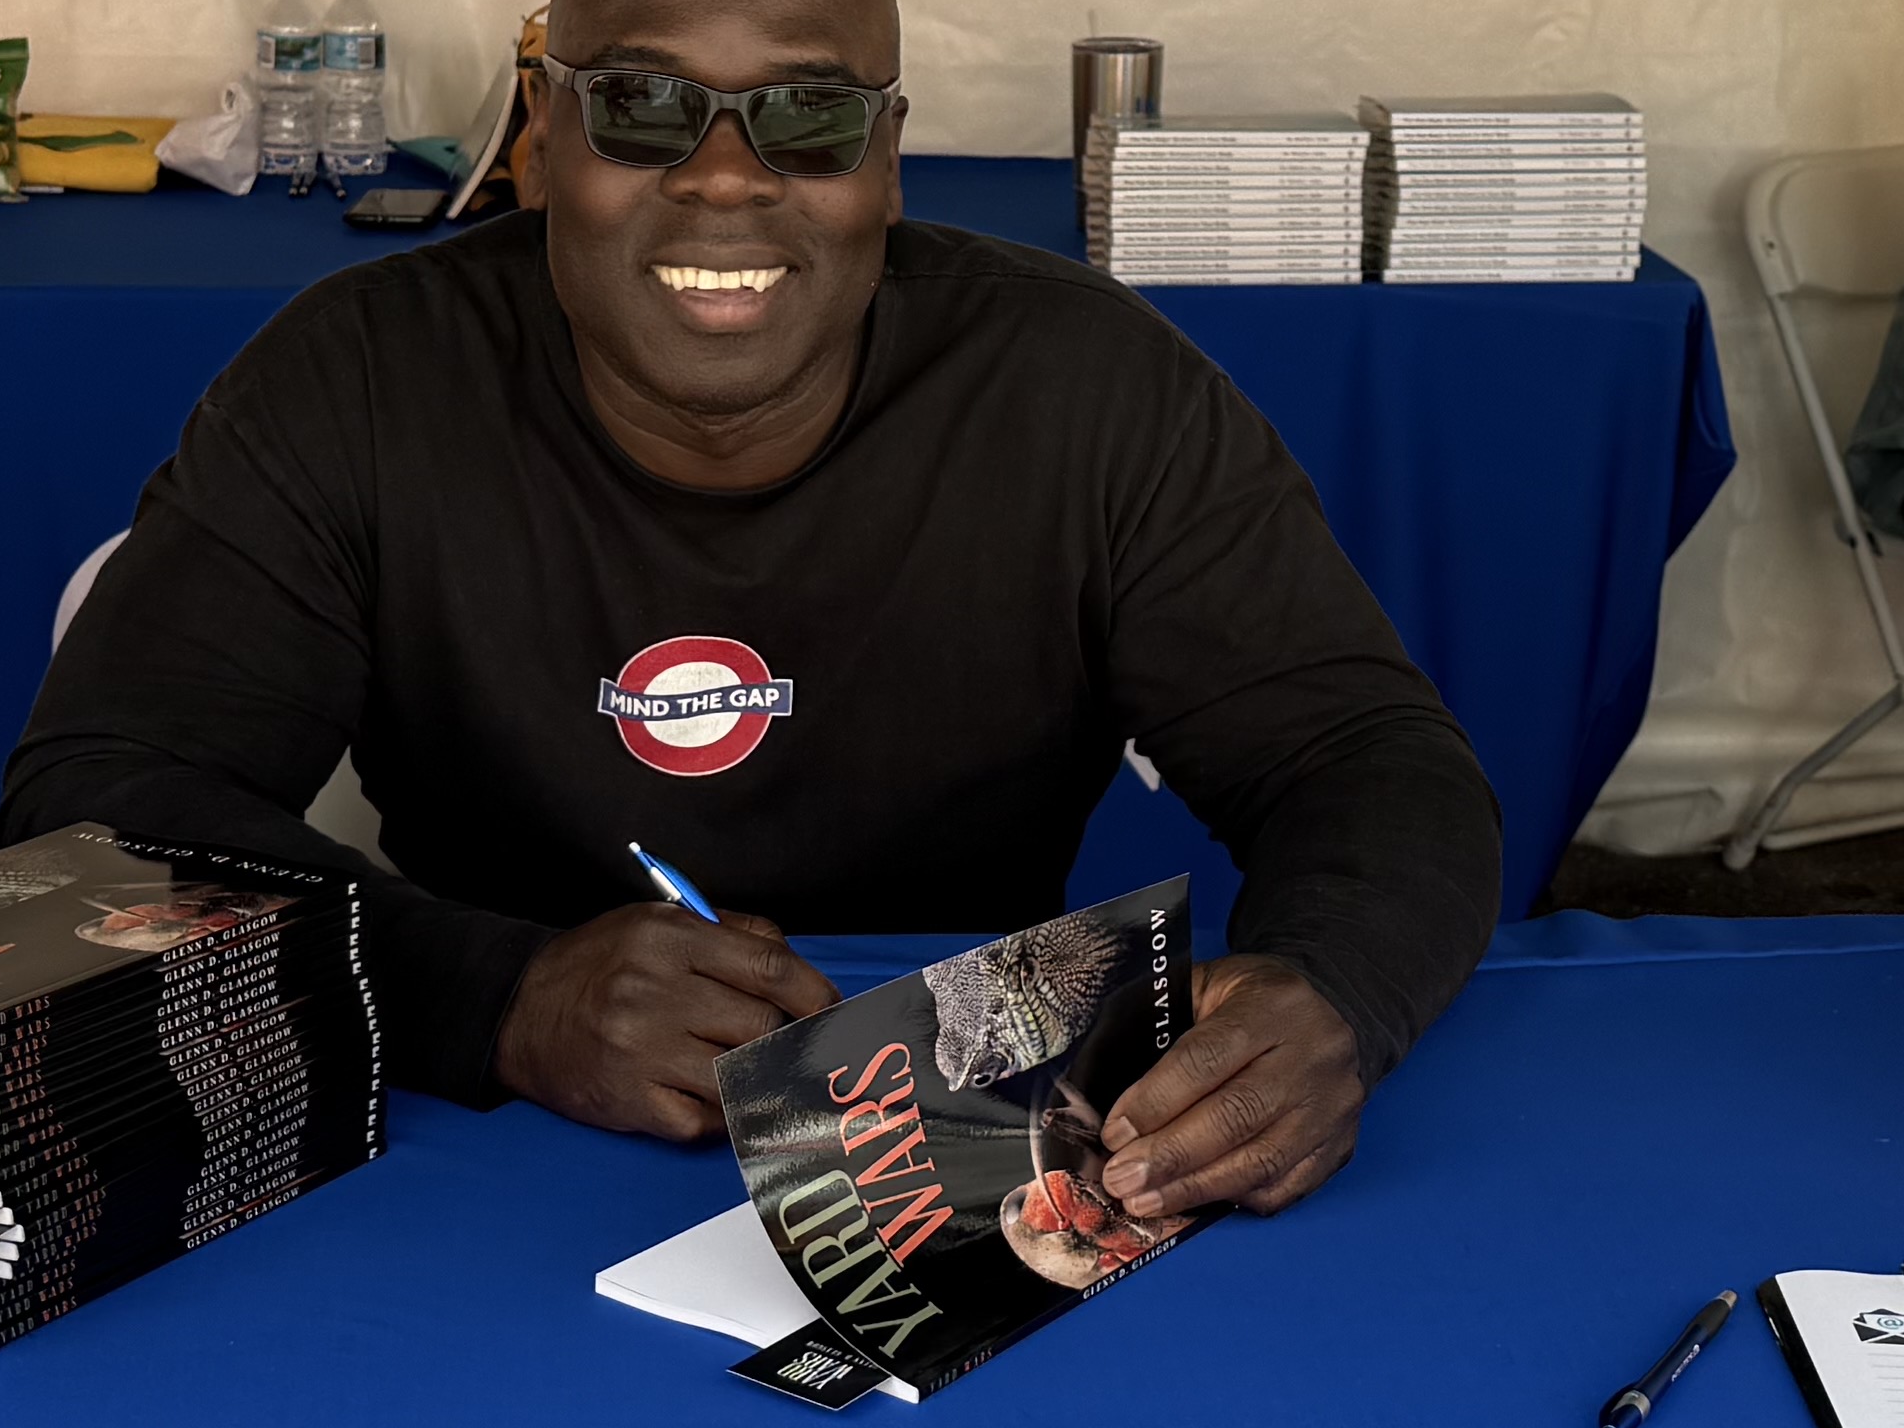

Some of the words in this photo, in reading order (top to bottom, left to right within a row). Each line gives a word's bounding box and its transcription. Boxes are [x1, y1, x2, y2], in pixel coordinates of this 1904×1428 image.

[609, 690, 670, 717] MIND
[677, 692, 723, 716] THE
[729, 688, 780, 708] GAP
[71, 831, 194, 858] GLASGOW
[207, 852, 231, 864] D.
[235, 860, 325, 884] GLENN
[163, 940, 202, 963] GLENN
[207, 936, 218, 947] D.
[222, 912, 278, 941] GLASGOW
[164, 960, 204, 983] GLENN
[209, 956, 221, 967] D.
[224, 931, 280, 960] GLASGOW
[157, 994, 198, 1017] GLENN
[203, 990, 215, 1001] D.
[219, 964, 276, 993] GLASGOW
[162, 977, 202, 1000] GLENN
[207, 972, 219, 983] D.
[223, 947, 280, 976] GLASGOW
[1150, 909, 1170, 1049] GLASGOW
[158, 1010, 199, 1033] GLENN
[203, 1005, 215, 1016] D.
[220, 980, 276, 1009] GLASGOW
[829, 1042, 954, 1268] WARS
[778, 1169, 944, 1359] YARD
[1083, 1273, 1115, 1300] GLENN
[776, 1362, 830, 1390] YARD
[793, 1351, 853, 1380] WARS
